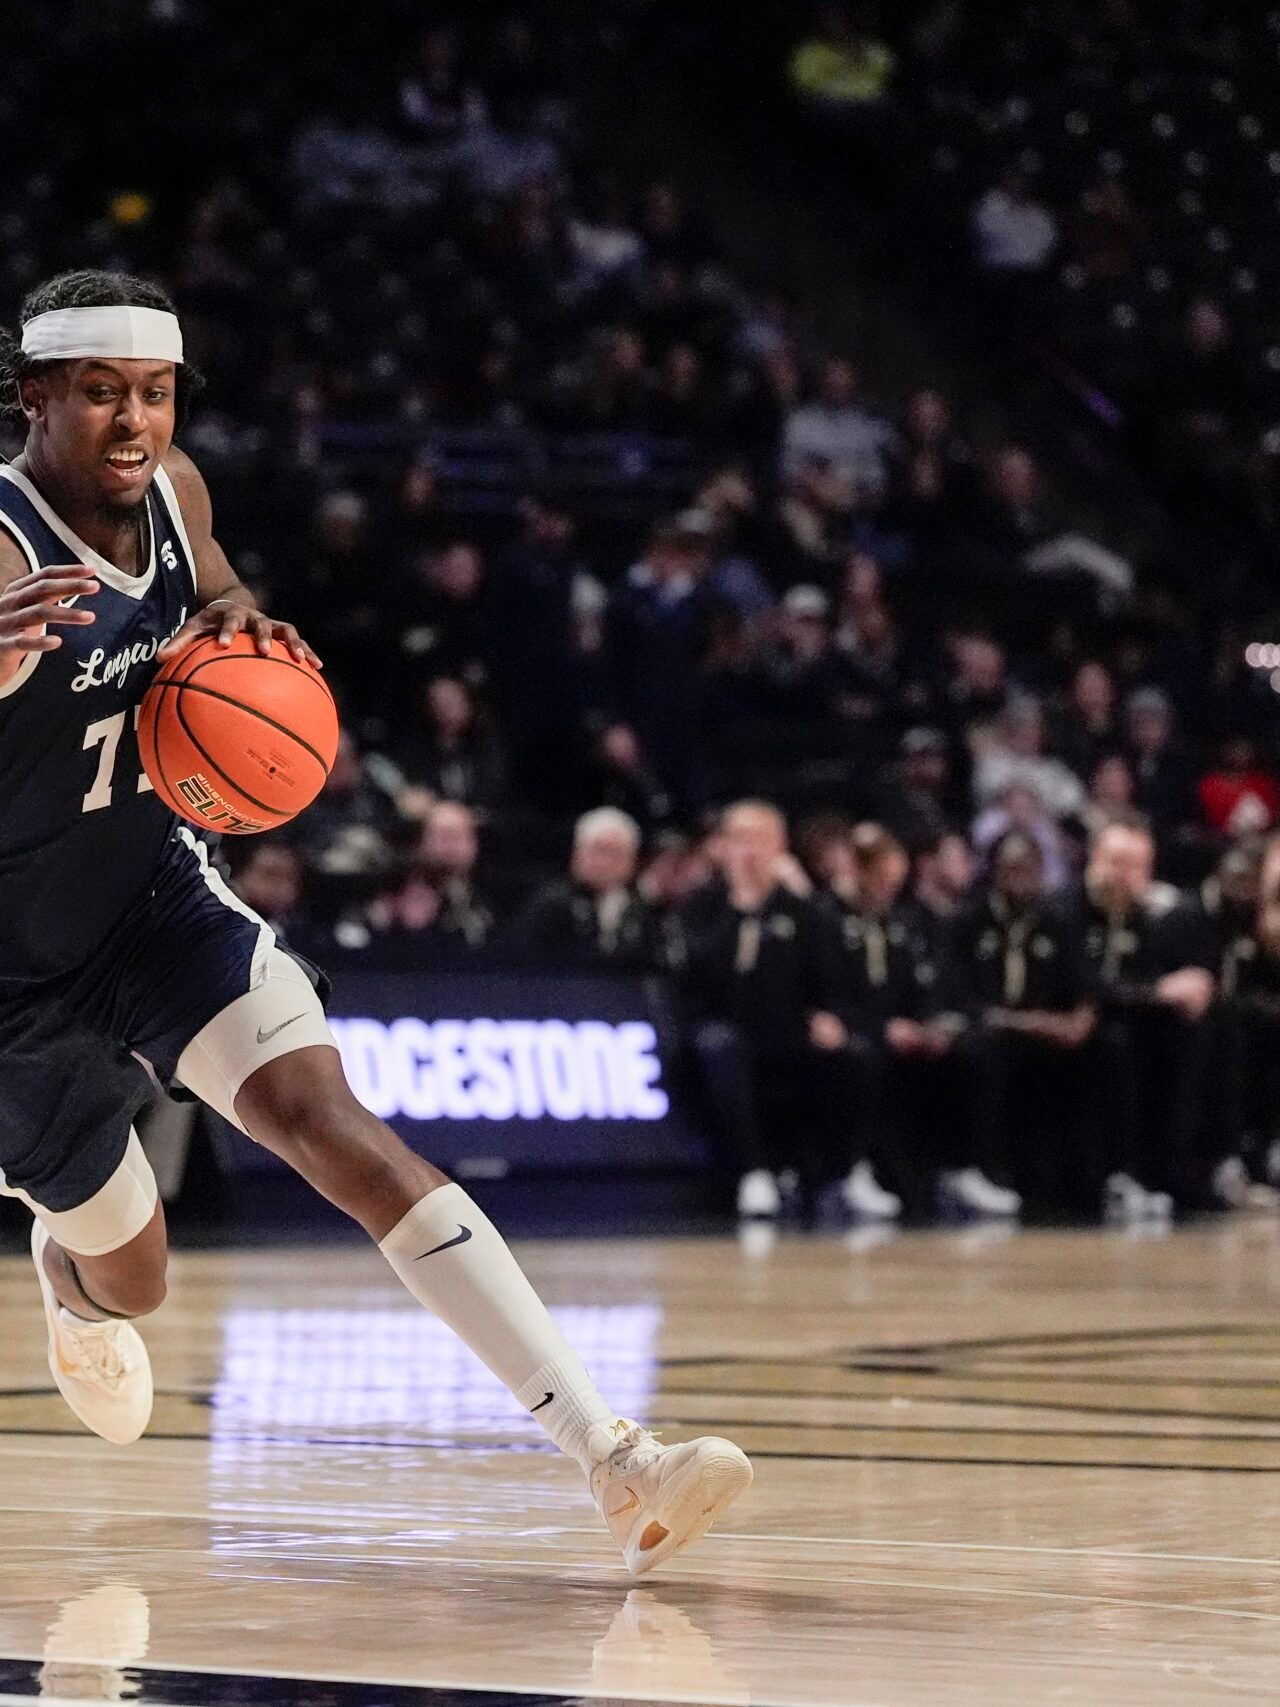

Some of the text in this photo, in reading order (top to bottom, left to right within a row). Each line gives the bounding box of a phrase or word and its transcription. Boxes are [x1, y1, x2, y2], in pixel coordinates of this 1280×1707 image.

[71, 607, 187, 692] Longwd
[82, 704, 154, 813] 7
[176, 775, 265, 834] ELITE
[326, 1017, 670, 1121] DGESTONE
